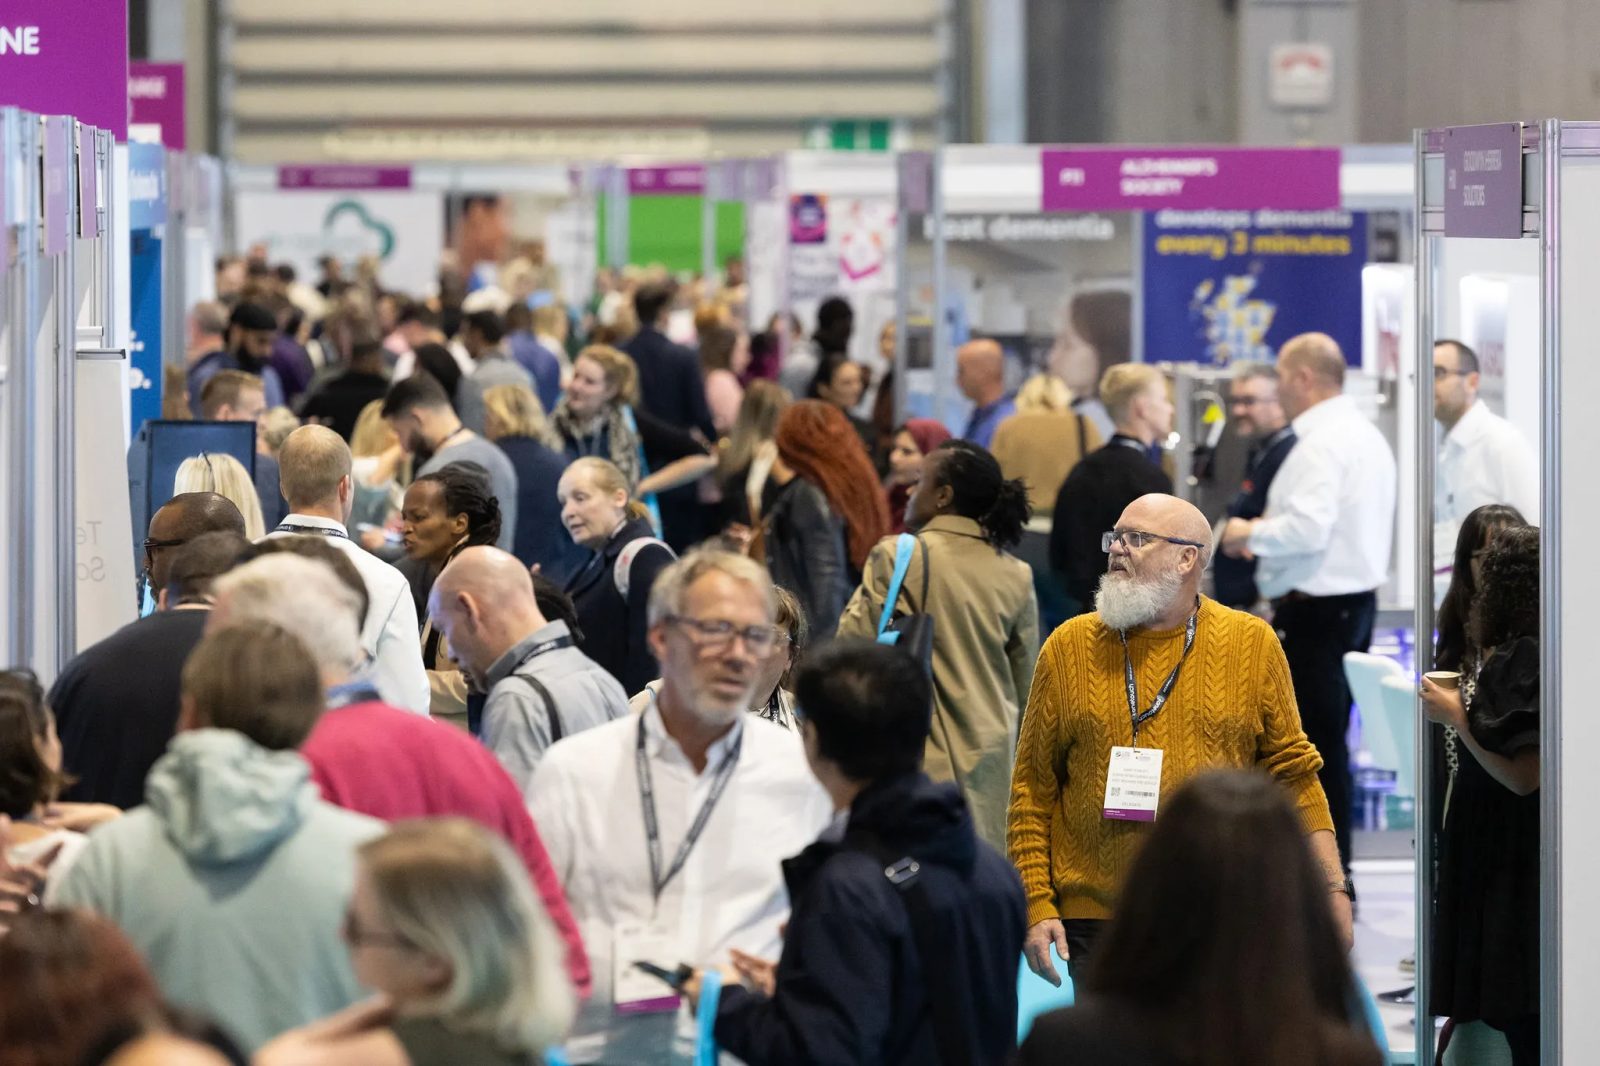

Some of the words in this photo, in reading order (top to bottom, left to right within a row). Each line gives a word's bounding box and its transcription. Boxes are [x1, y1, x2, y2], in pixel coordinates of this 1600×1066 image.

[0, 26, 40, 55] NE
[1121, 178, 1185, 196] SOCIETY
[988, 213, 1115, 240] dementia
[1156, 208, 1250, 232] develops
[1254, 208, 1352, 229] dementia
[1157, 235, 1228, 259] every
[1233, 231, 1248, 254] 3
[1253, 234, 1350, 255] minutes
